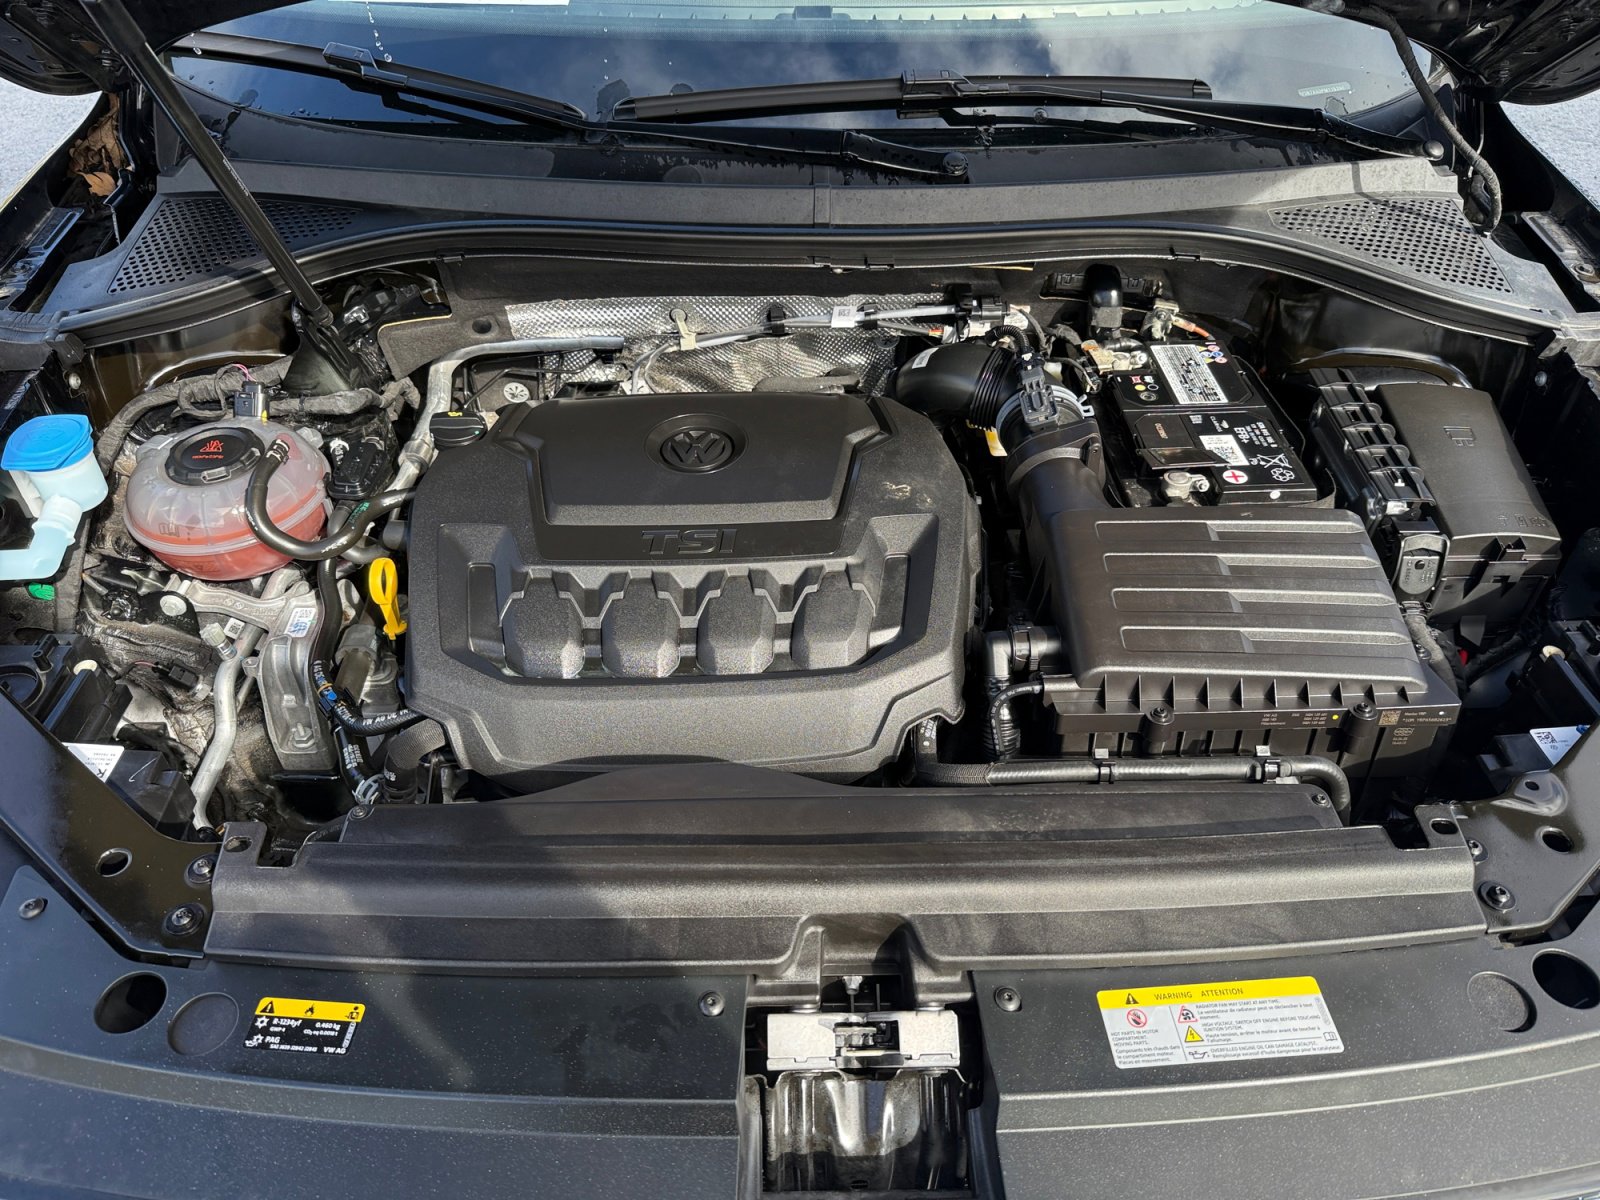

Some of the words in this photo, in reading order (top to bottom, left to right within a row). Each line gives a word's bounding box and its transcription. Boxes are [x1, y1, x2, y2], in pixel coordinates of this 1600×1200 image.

[1233, 427, 1250, 444] EFB+
[641, 528, 737, 555] TSI
[1154, 991, 1193, 1000] WARNING
[1201, 988, 1244, 997] ATTENTION
[272, 1018, 302, 1028] R-1234yf
[264, 1035, 281, 1044] PAG
